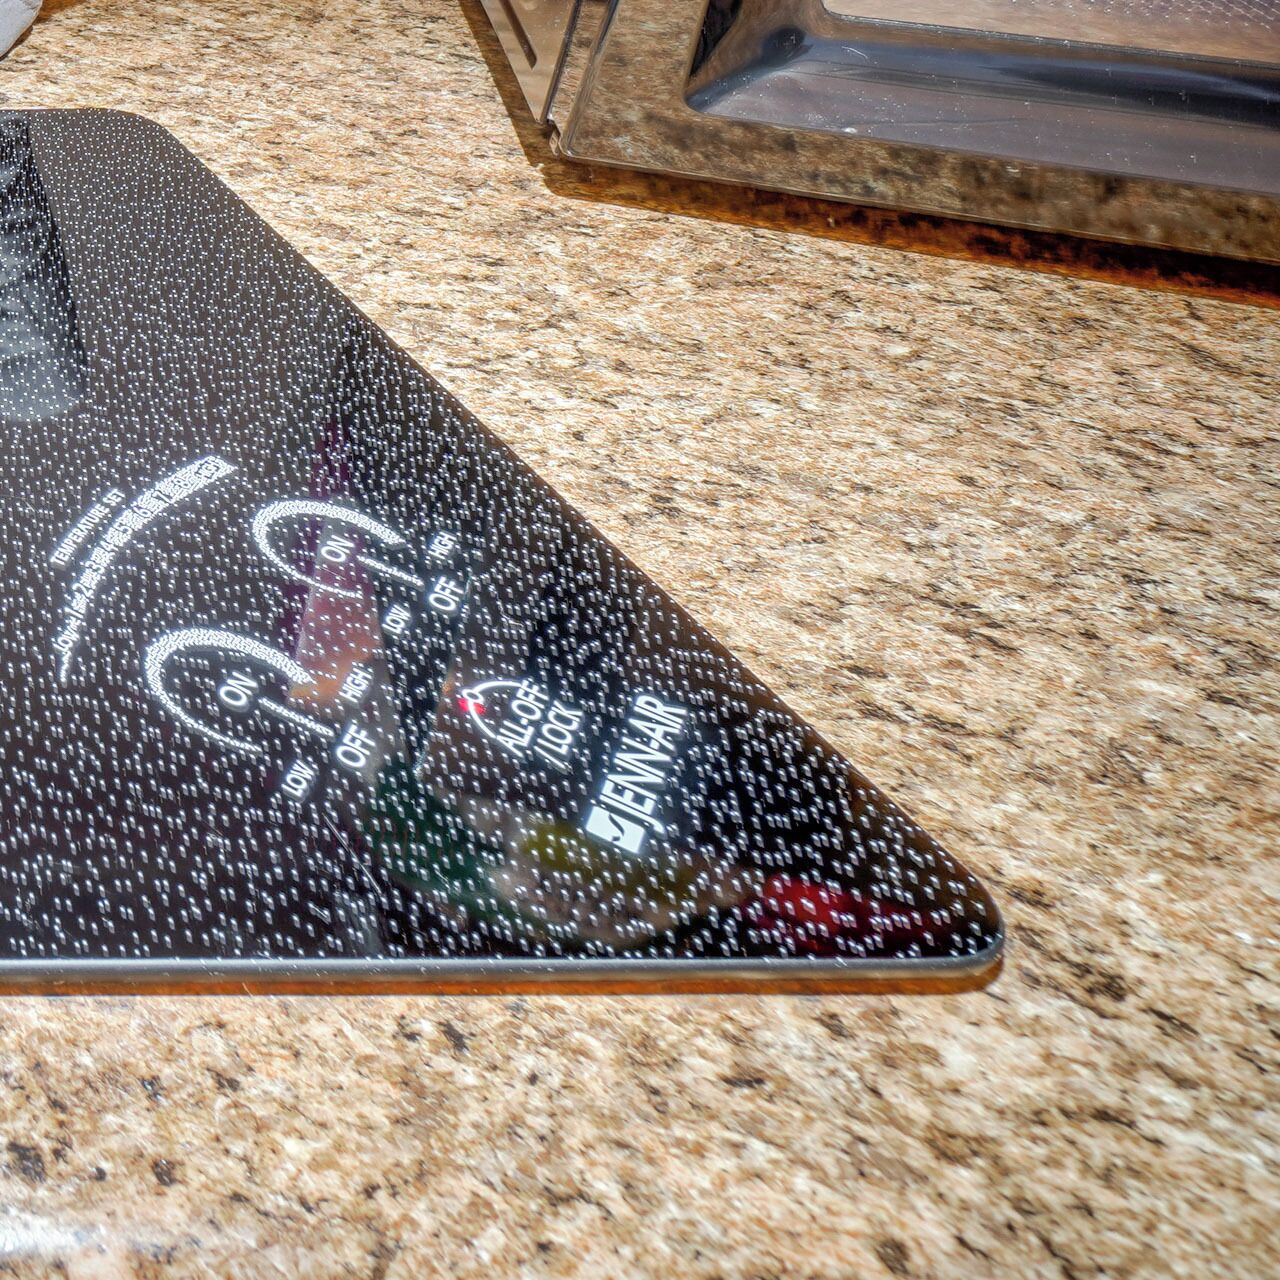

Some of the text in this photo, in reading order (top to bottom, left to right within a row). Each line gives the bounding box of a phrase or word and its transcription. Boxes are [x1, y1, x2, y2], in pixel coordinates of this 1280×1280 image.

[49, 488, 127, 566] TEMPERATURE SET
[428, 531, 457, 559] HIGH
[321, 534, 356, 563] ON
[52, 626, 81, 654] LOW
[72, 581, 94, 599] 2
[84, 559, 105, 575] 3
[115, 517, 134, 536] 5
[151, 490, 175, 505] 7
[429, 576, 465, 611] OFF
[382, 604, 412, 635] LOW
[219, 671, 258, 706] ON
[339, 667, 373, 703] HIGH
[496, 679, 550, 758] ALL-OFF
[533, 700, 583, 770] /LOCK
[336, 724, 376, 768] OFF
[599, 694, 688, 835] JENN-AIR
[281, 759, 315, 797] LOW
